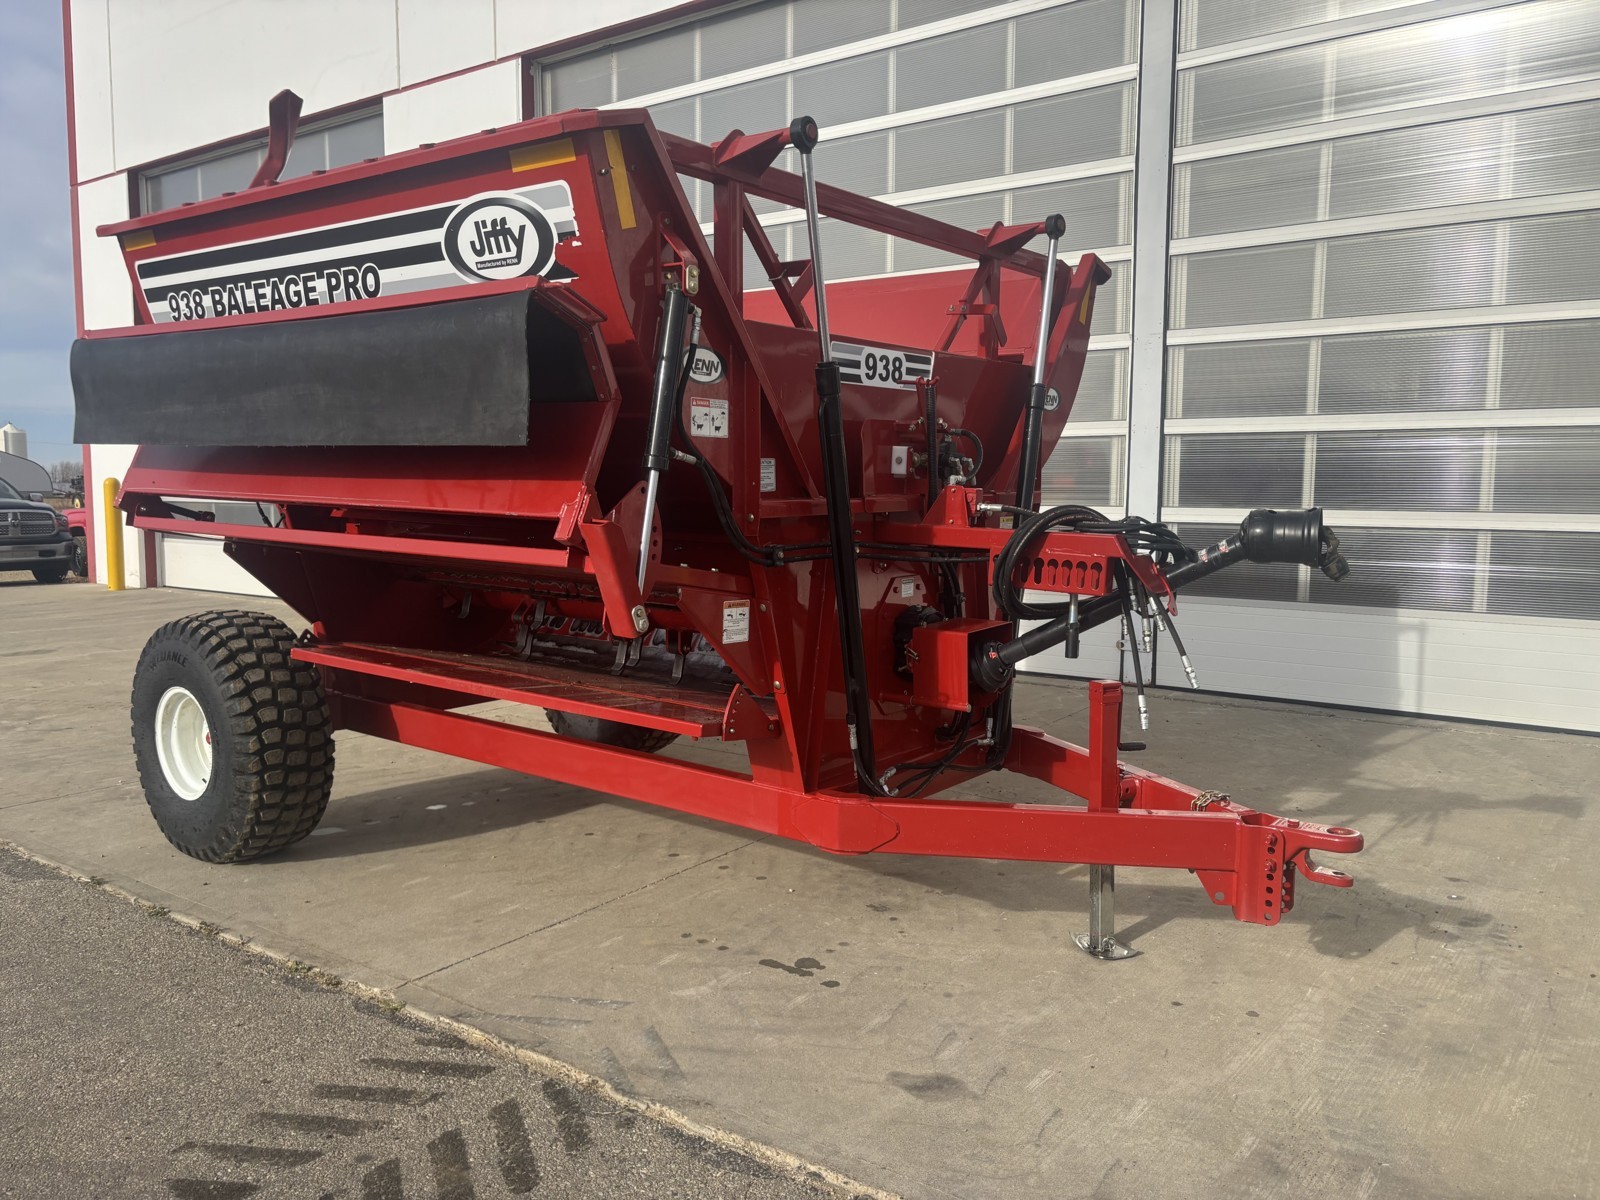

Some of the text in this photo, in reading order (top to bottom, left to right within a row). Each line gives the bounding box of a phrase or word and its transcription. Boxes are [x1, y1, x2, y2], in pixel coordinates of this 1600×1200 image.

[470, 217, 526, 264] Jiffy
[477, 261, 501, 269] Manufactured
[168, 263, 381, 322] 938 BALEAGE PRO
[692, 357, 720, 376] ENN
[864, 352, 903, 385] 938
